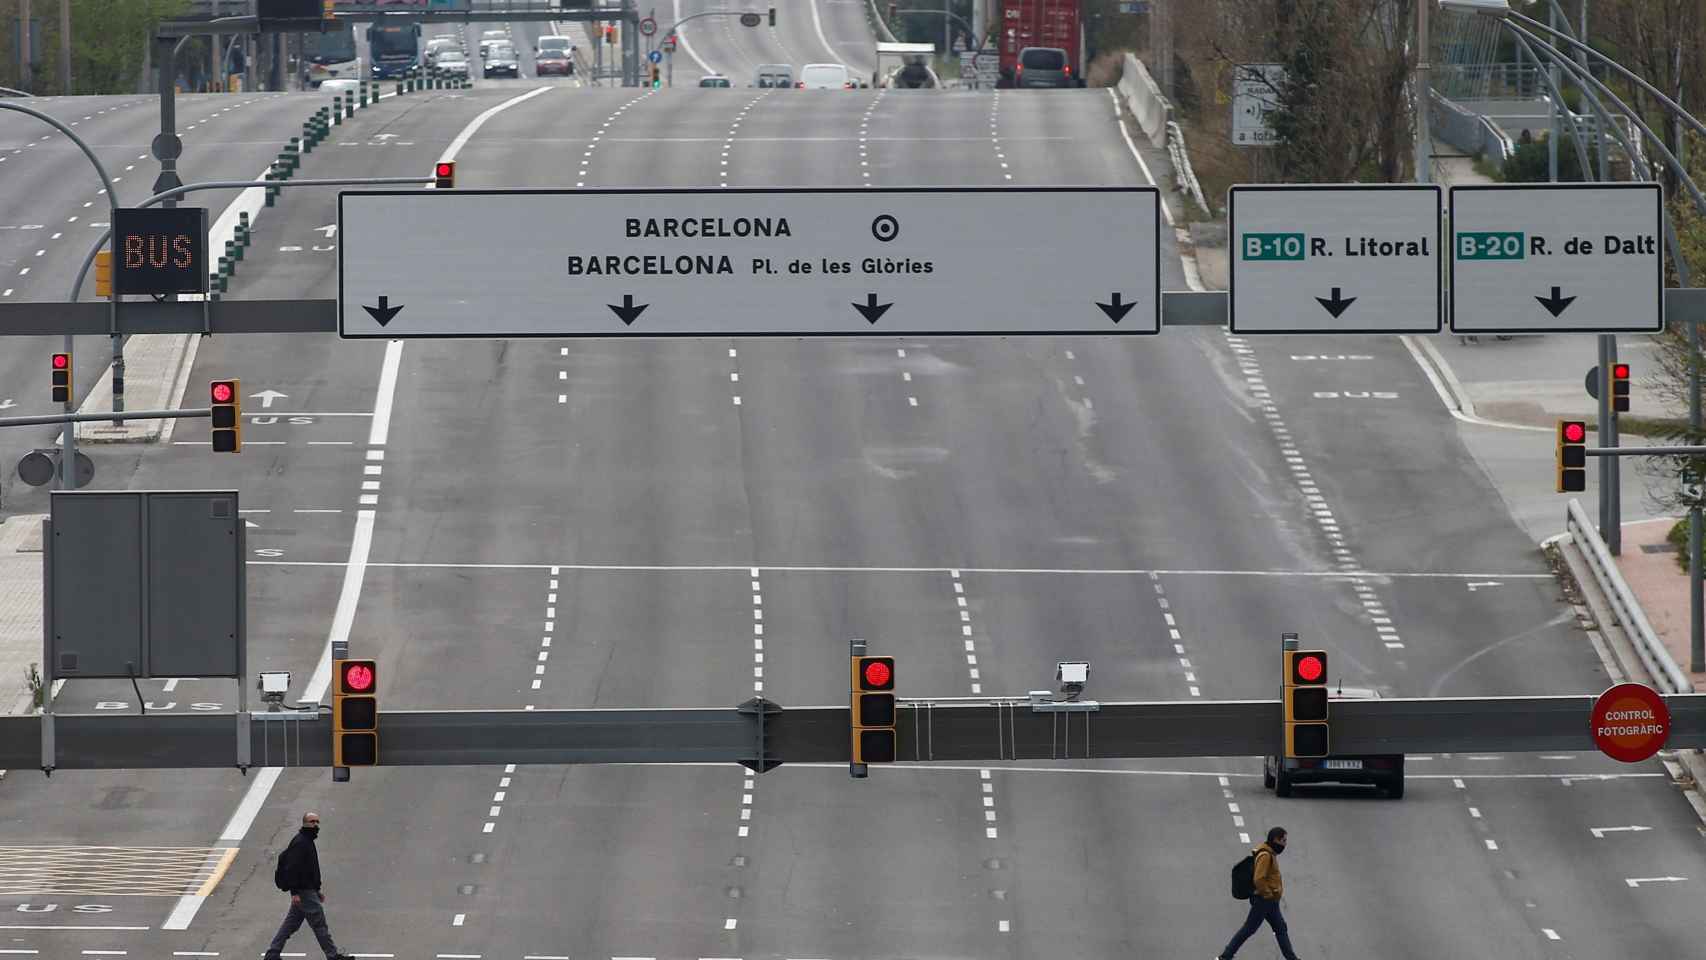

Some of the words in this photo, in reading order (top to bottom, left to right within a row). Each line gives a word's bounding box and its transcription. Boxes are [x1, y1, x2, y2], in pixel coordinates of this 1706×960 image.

[626, 218, 791, 238] BARCELONA
[125, 234, 192, 269] BUS
[1247, 237, 1300, 257] B-10
[1310, 237, 1333, 257] R.
[1345, 236, 1430, 257] Litoral
[1461, 237, 1520, 256] B-20
[1531, 236, 1553, 256] R.
[1564, 236, 1594, 256] de
[1605, 235, 1656, 256] Dalt
[568, 256, 734, 276] BARCELONA
[752, 259, 778, 274] Pl.
[788, 259, 813, 274] de
[823, 259, 852, 274] les
[861, 257, 934, 274] Glòries
[250, 416, 314, 425] US
[95, 701, 224, 711] BUS
[1605, 710, 1655, 721] CONTROL
[1597, 723, 1664, 737] FOTOGRÀFIC
[16, 903, 113, 913] US
